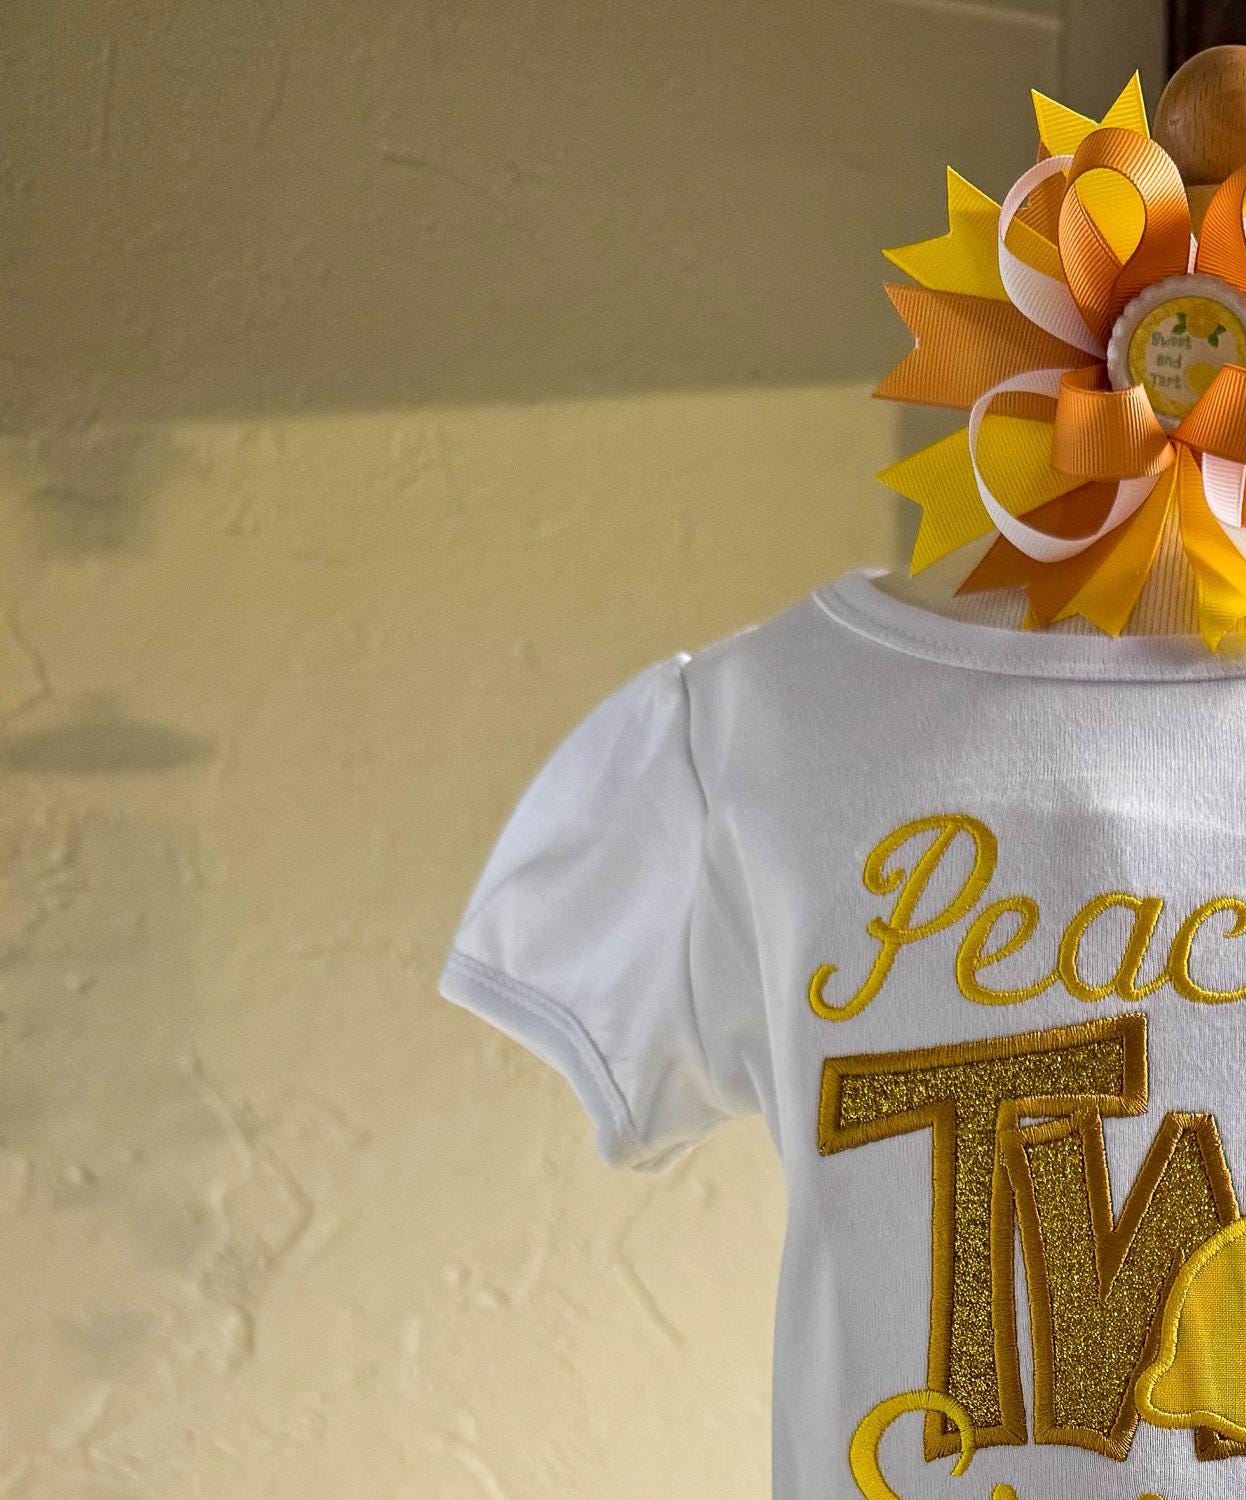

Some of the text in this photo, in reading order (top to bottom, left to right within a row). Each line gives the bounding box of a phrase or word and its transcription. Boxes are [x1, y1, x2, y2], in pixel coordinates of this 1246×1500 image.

[1151, 331, 1192, 350] Sweet
[1156, 353, 1182, 369] and
[1150, 373, 1181, 389] Tart
